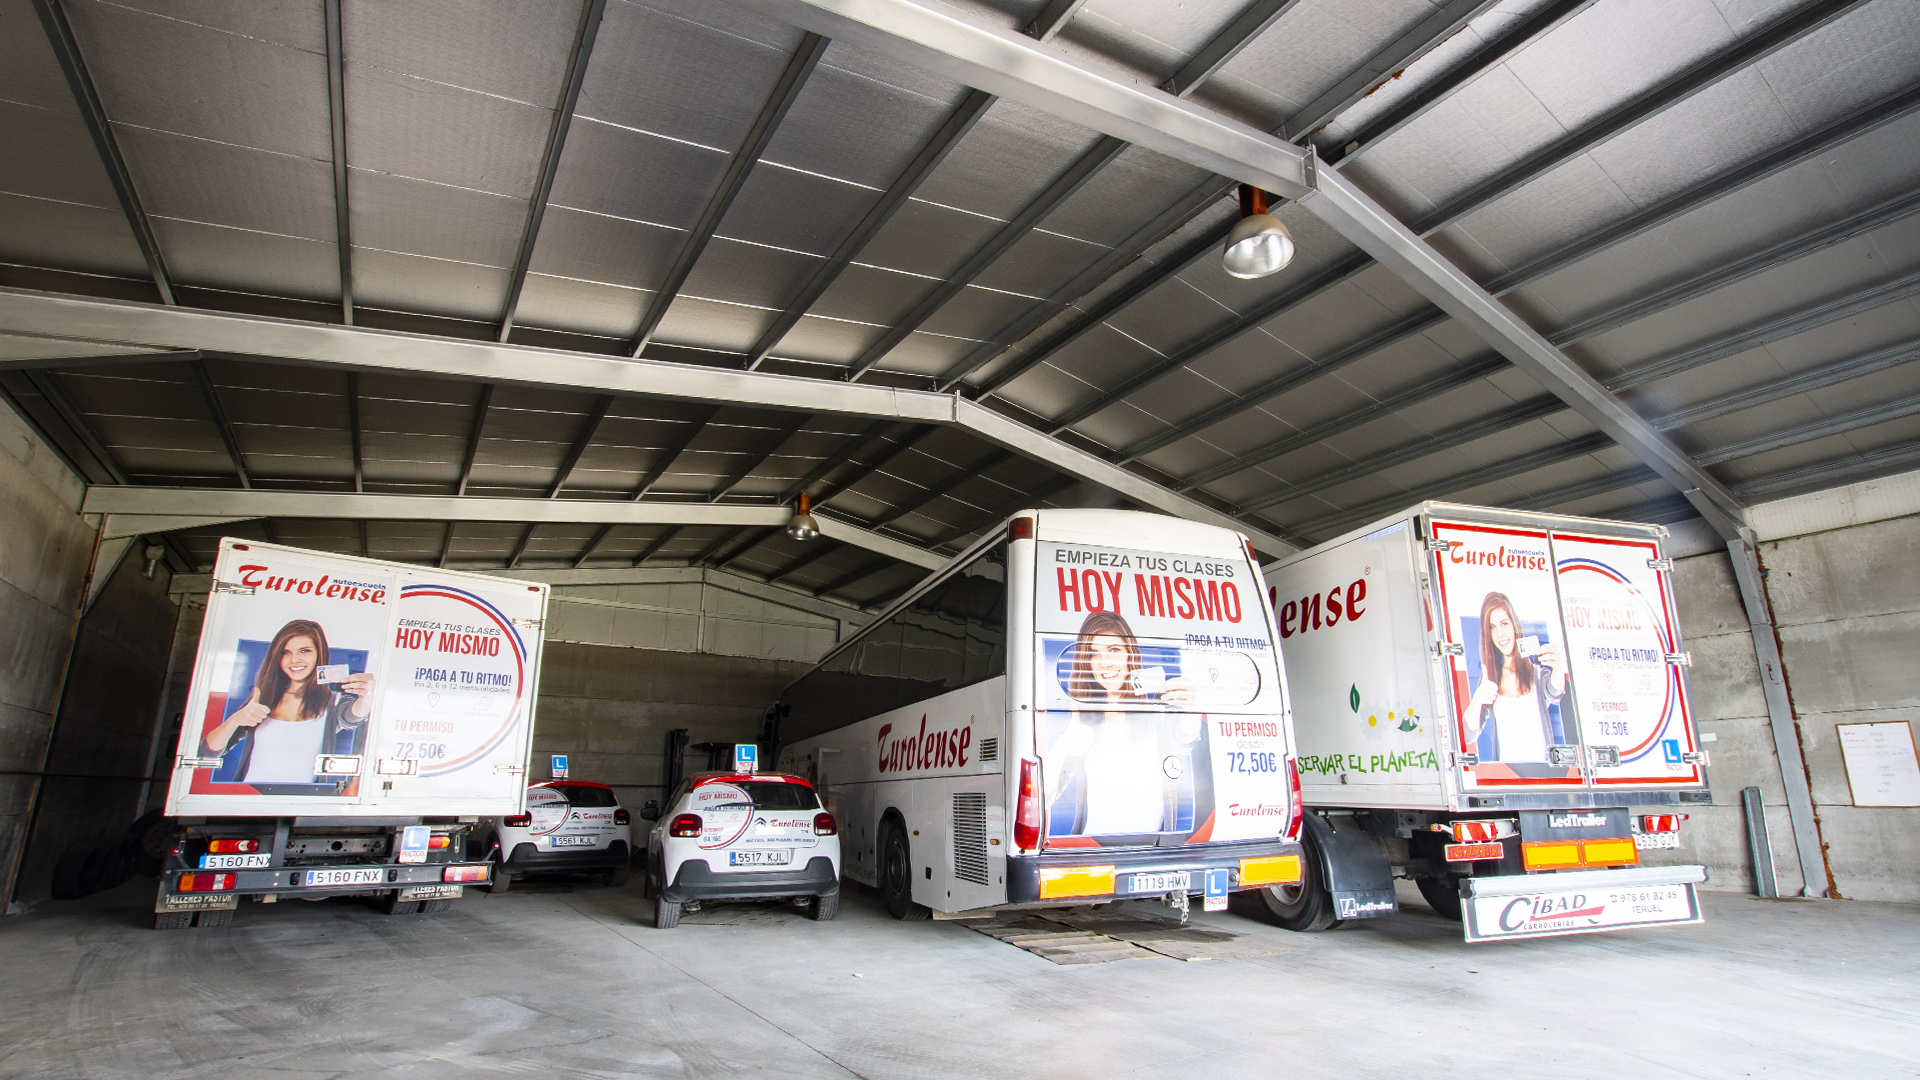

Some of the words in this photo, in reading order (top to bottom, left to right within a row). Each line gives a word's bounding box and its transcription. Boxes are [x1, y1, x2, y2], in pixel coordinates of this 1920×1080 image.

[1055, 549, 1131, 568] EMPIEZA
[1136, 556, 1168, 571] TUS
[1173, 560, 1234, 578] CLASES
[332, 578, 386, 590] autoescuela
[1056, 567, 1123, 615] HOY
[1134, 573, 1242, 624] MISMO
[1565, 606, 1591, 628] HOY
[1597, 607, 1641, 630] MISMO
[398, 618, 441, 630] EMPIEZA
[444, 623, 462, 632] TUS
[465, 625, 501, 636] CLASES
[395, 627, 435, 651] HOY
[438, 632, 500, 657] MISMO
[1215, 636, 1221, 647] A
[1222, 636, 1234, 649] TU
[1614, 648, 1620, 660] A
[1620, 648, 1631, 661] TU
[415, 667, 446, 682] ¡PAGA
[449, 670, 457, 682] A
[460, 670, 474, 684] TU
[476, 672, 512, 687] RITMO!
[459, 684, 511, 694] mensualidades
[1592, 701, 1600, 712] TU
[1601, 702, 1628, 712] PERMISO
[395, 719, 407, 731] TU
[409, 720, 454, 733] PERMISO
[1219, 722, 1232, 737] TU
[1234, 722, 1277, 738] PERMISO
[408, 733, 437, 741] desde
[1236, 739, 1265, 749] desde
[742, 747, 751, 760] L
[1664, 742, 1679, 760] L
[556, 758, 564, 768] L
[1227, 752, 1277, 776] 72,50€
[1348, 754, 1367, 774] EL
[1370, 748, 1440, 773] PLANETA
[698, 793, 713, 801] HOY
[770, 819, 812, 828] Turolense
[1549, 813, 1607, 828] LedTrailer
[408, 830, 421, 848] L
[558, 837, 576, 845] 5561
[1660, 834, 1675, 846] GJY
[1484, 845, 1503, 856] BCN
[209, 856, 243, 867] 5160
[247, 855, 271, 866] FNX
[738, 853, 761, 862] 5517
[767, 852, 784, 862] KJL
[317, 872, 351, 883] 5160
[354, 871, 380, 882] FNX
[1138, 877, 1164, 890] 1119
[1168, 875, 1188, 888] HMV
[1210, 875, 1222, 894] L
[1620, 893, 1637, 902] 978
[1640, 892, 1650, 901] 61
[1653, 892, 1665, 901] 82
[1667, 891, 1677, 899] 45
[1356, 901, 1393, 911] LedTrailer
[1632, 905, 1663, 914] TERUEL
[1523, 919, 1575, 930] CARROCERIAS
